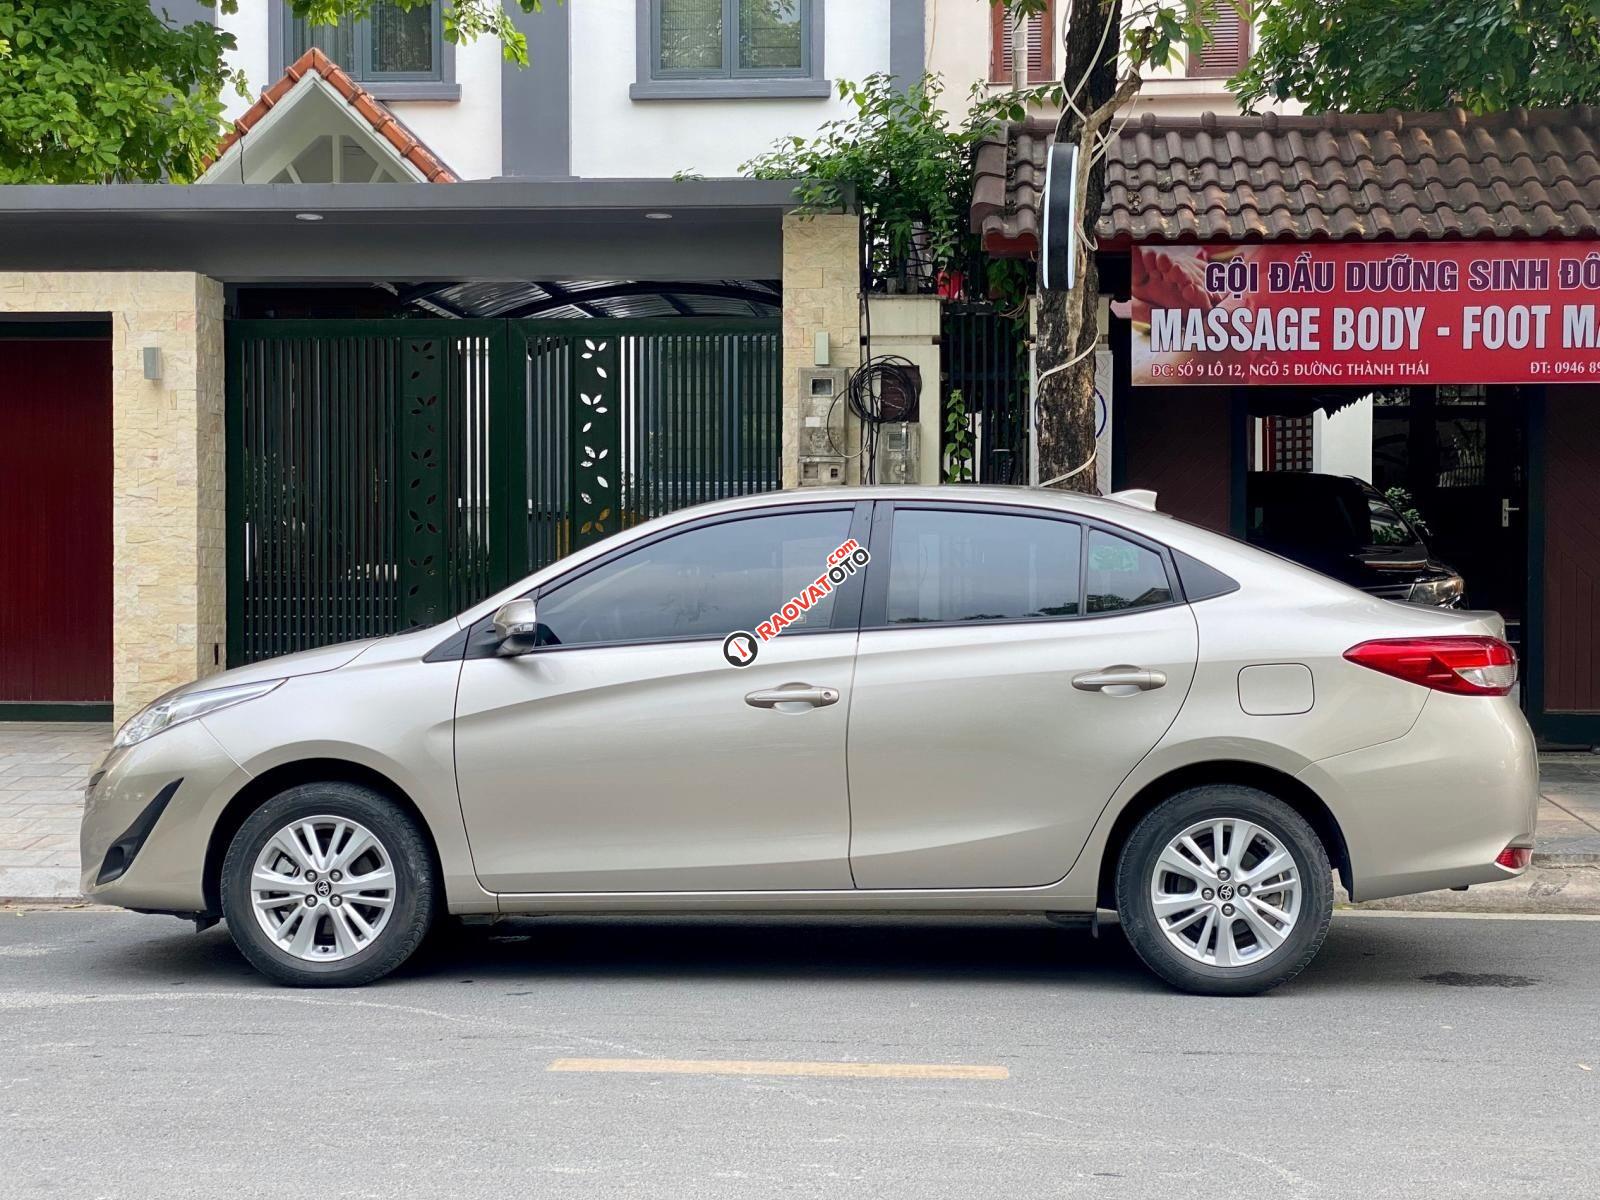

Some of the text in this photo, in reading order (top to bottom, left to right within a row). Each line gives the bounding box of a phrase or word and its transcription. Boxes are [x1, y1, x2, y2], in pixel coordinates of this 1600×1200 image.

[1205, 255, 1259, 298] GỘI
[1268, 251, 1335, 293] ĐẦU
[1345, 253, 1459, 293] DƯỠNG
[1468, 258, 1550, 291] SINH
[1151, 307, 1320, 352] MASSAGE
[1333, 306, 1425, 351] BODY
[1463, 305, 1551, 349] FOOT
[1562, 304, 1600, 349] M
[1152, 358, 1430, 379] ĐC: SỐ 9 LÔ 12, NGÕ 5 ĐƯỜNG THÀNH THÁI
[1530, 361, 1551, 375] ĐT:
[1555, 361, 1585, 374] 0946
